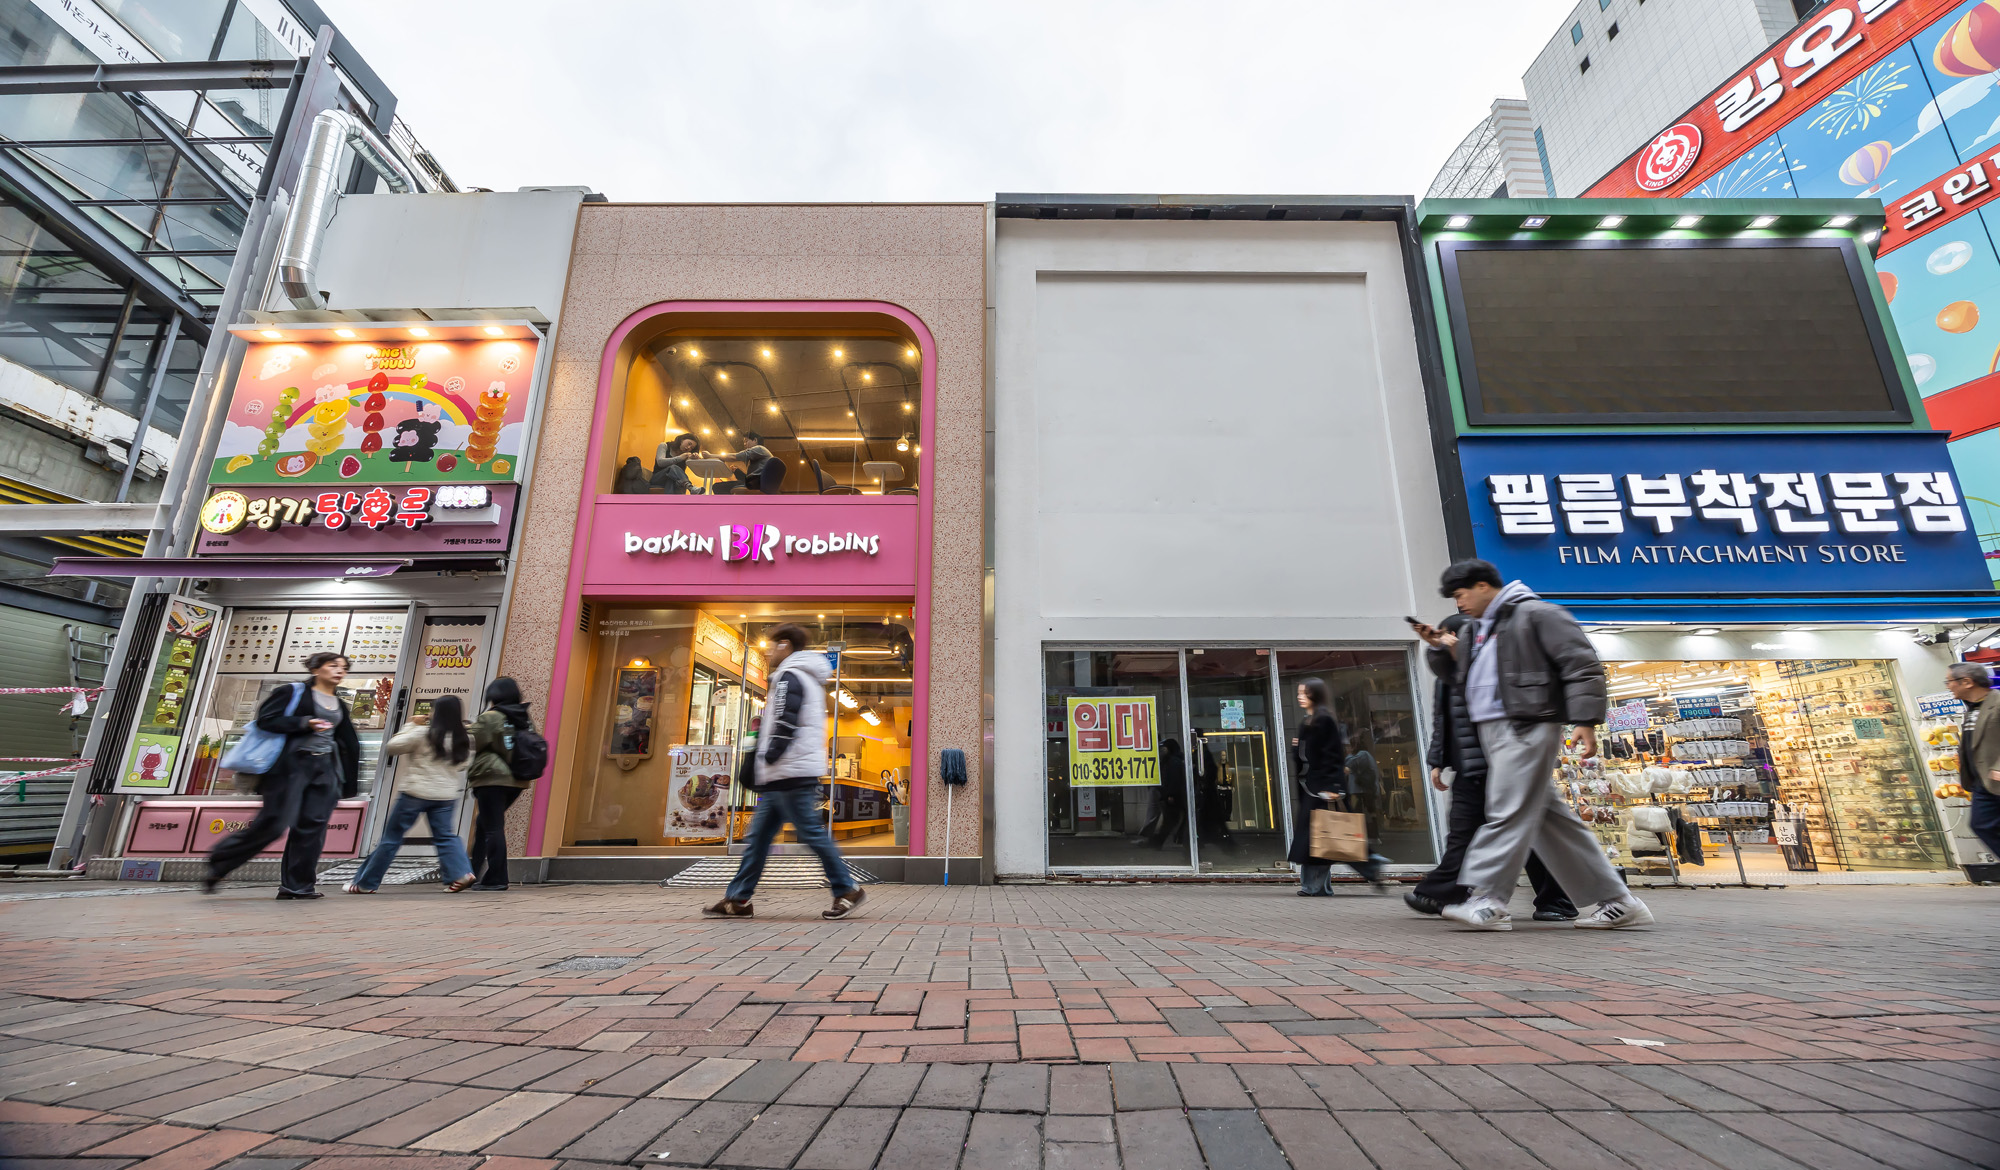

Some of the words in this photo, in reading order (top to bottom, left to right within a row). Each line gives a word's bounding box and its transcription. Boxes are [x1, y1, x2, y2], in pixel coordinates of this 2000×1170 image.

[1644, 179, 1664, 187] KING
[1666, 145, 1697, 183] ARCADE
[379, 359, 416, 369] HULU
[1488, 469, 1968, 535] 필름부착전문점
[624, 530, 715, 556] baskin
[785, 532, 880, 556] robbins
[1558, 546, 1621, 564] FILM
[1631, 545, 1809, 564] ATTACHMENT
[1821, 544, 1907, 563] STORE
[424, 645, 458, 656] TANG
[438, 657, 472, 668] HULU
[443, 686, 470, 694] Brulee
[1073, 702, 1153, 752] 임대
[676, 752, 728, 766] DUBAI
[1072, 757, 1157, 781] 010-3513-1717
[127, 868, 155, 879] 점검구
